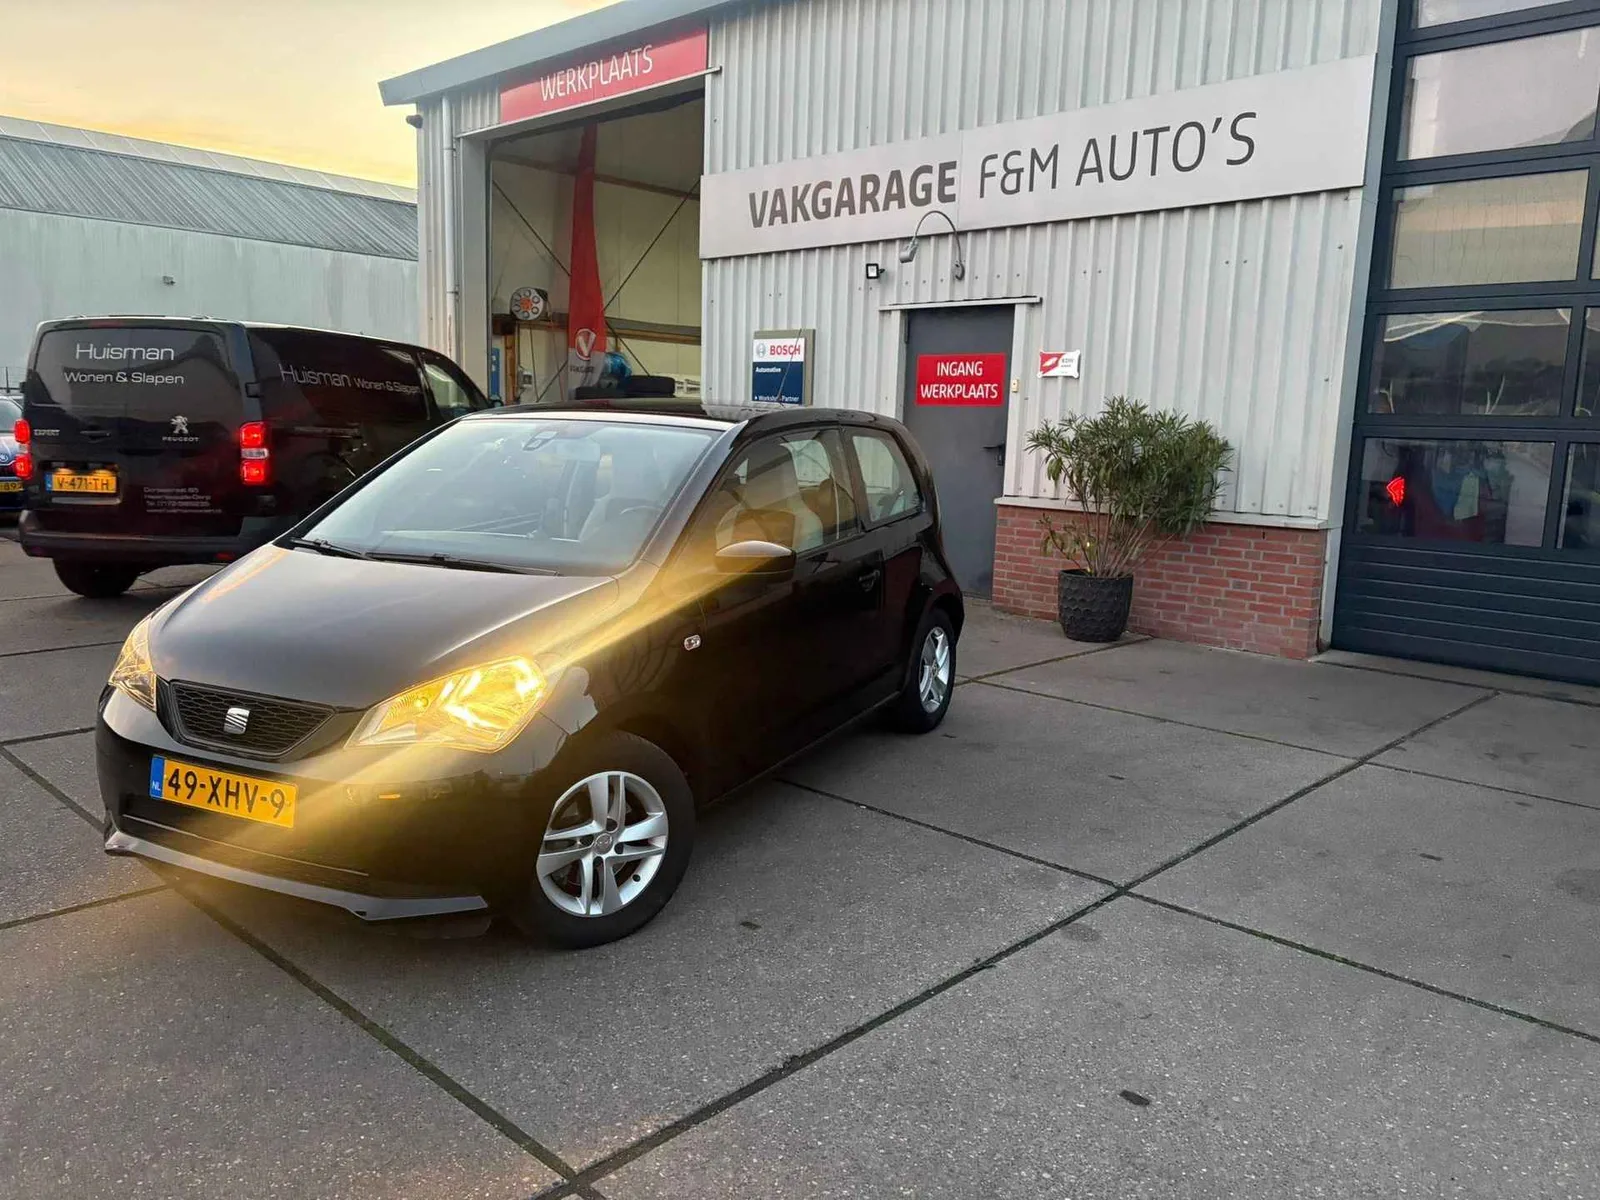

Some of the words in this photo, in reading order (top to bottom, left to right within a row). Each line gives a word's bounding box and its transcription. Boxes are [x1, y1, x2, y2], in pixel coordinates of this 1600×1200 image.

[540, 44, 653, 102] WERKPLAATS
[748, 160, 958, 229] VAKGARAGE
[979, 143, 1060, 199] F&M
[1074, 111, 1257, 187] AUTO'S
[75, 343, 175, 361] Huisman
[769, 344, 801, 356] BOSCH
[278, 362, 352, 388] Huisman
[936, 360, 984, 377] INGANG
[64, 371, 113, 384] Wonen
[116, 371, 128, 384] &
[131, 371, 185, 386] Slapen
[920, 383, 999, 399] WERKPLAATS
[56, 476, 111, 491] V-471-TH
[167, 768, 286, 819] 49-XHV-9
